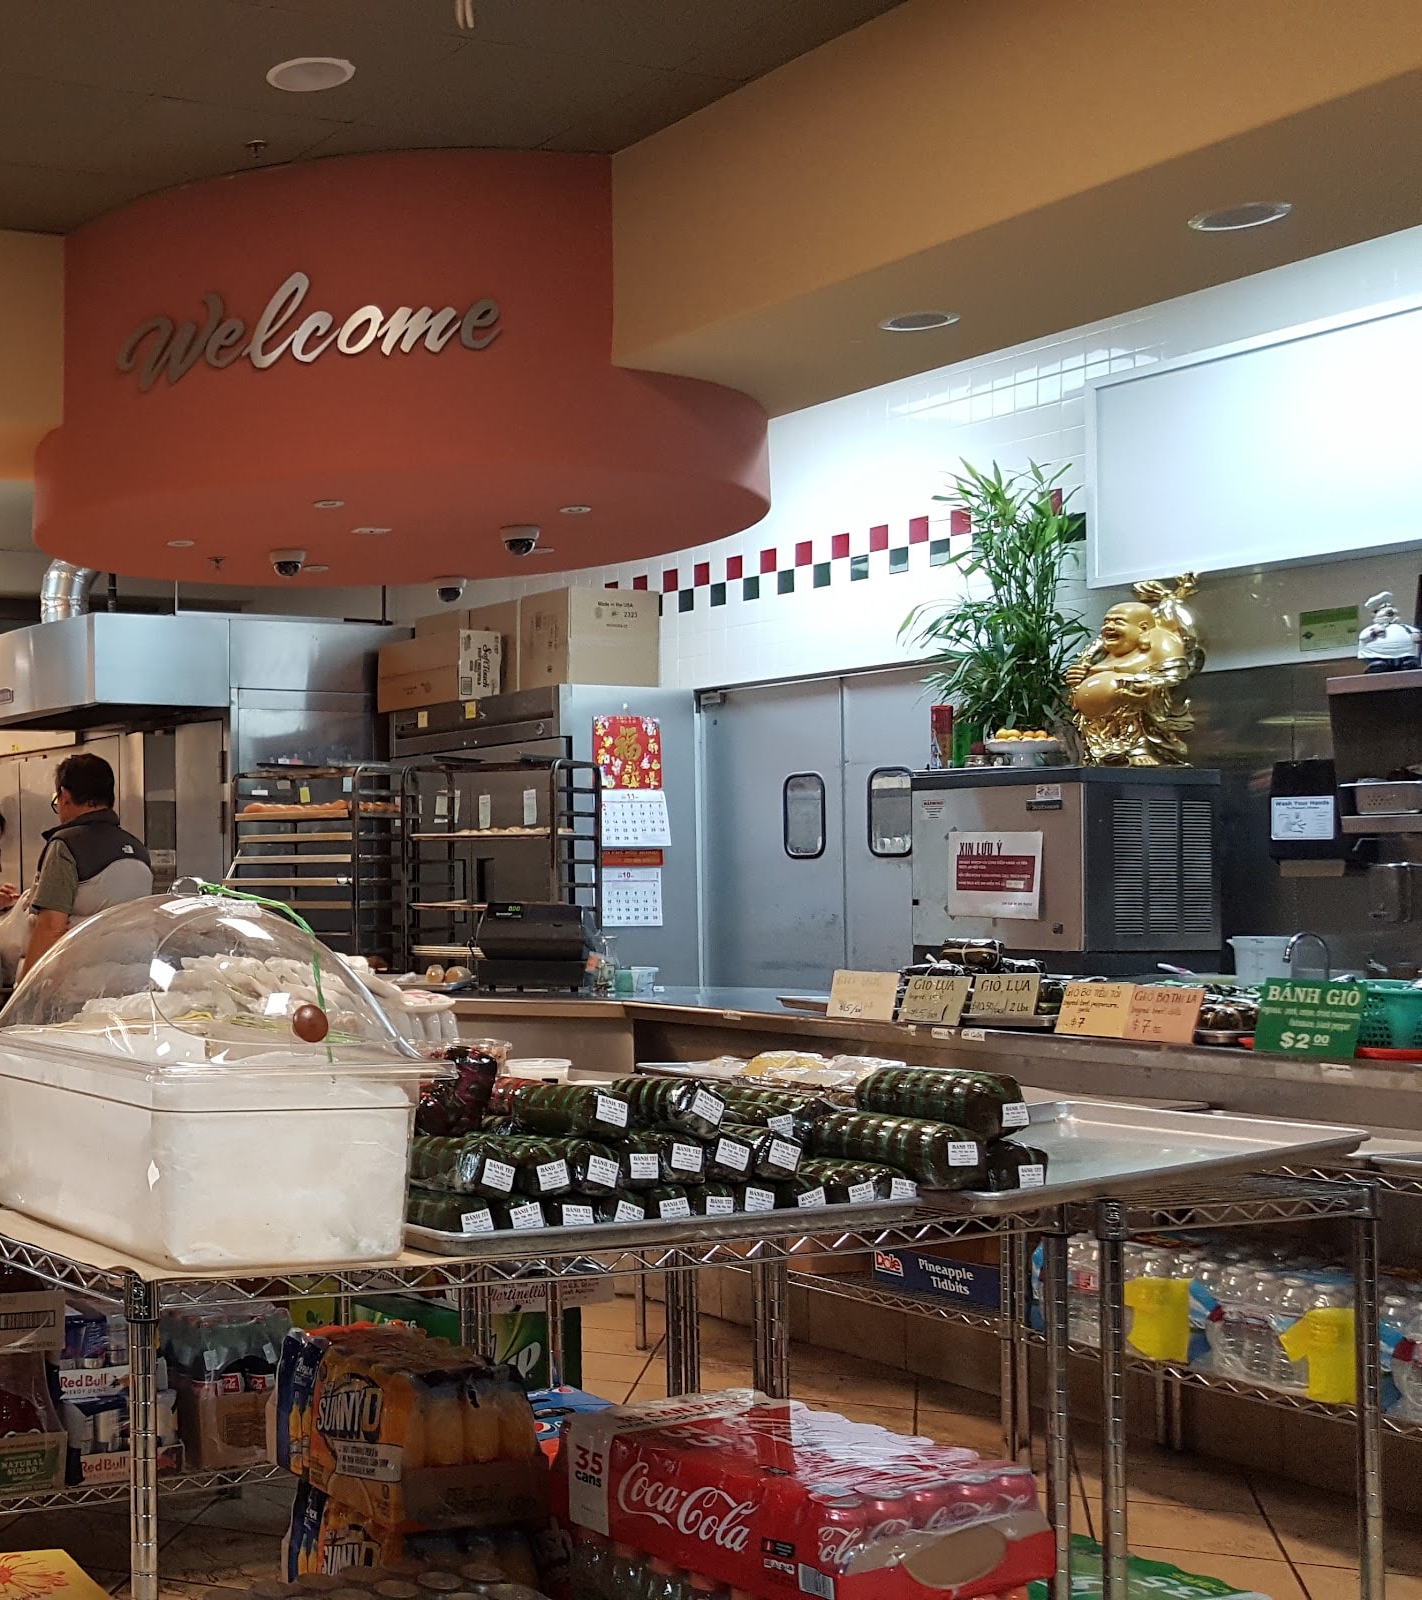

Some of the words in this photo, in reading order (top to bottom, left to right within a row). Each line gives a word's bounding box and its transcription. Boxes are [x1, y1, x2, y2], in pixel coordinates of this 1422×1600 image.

[116, 271, 502, 392] Welcome
[614, 726, 642, 761] 福
[959, 842, 974, 856] XIN
[996, 839, 1003, 856] Ý
[1267, 982, 1322, 1004] BÁNH
[1326, 986, 1361, 1007] GIÒ
[1279, 1031, 1311, 1049] $2
[876, 1251, 901, 1271] Dole
[918, 1258, 974, 1281] Pineapple
[930, 1275, 970, 1295] Tidbits
[59, 1375, 82, 1388] Red
[85, 1373, 107, 1387] Bull
[645, 1406, 690, 1419] CAN
[1, 1460, 44, 1470] NATURAL
[81, 1461, 102, 1473] Red
[104, 1456, 126, 1470] Bull
[575, 1443, 603, 1475] 35
[7, 1467, 37, 1476] SUGAR
[575, 1471, 602, 1488] cans
[617, 1461, 761, 1553] Coca-Cola
